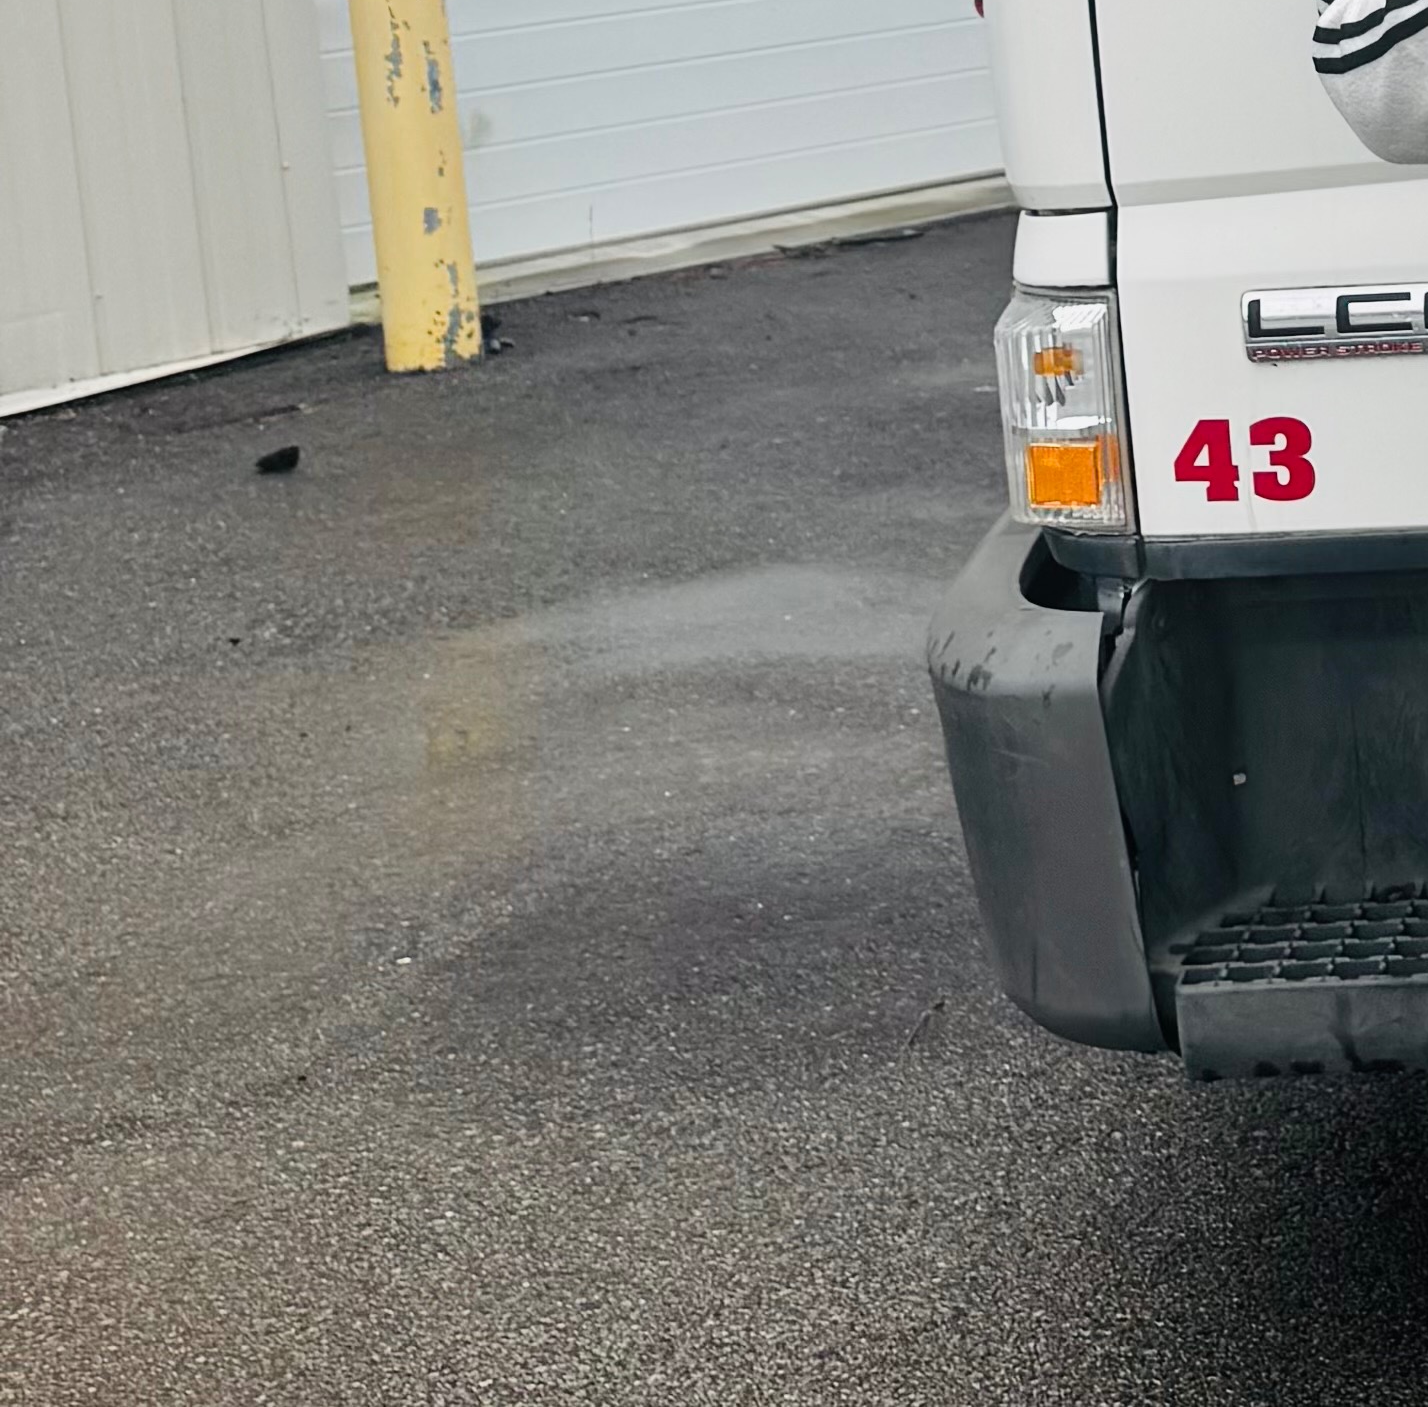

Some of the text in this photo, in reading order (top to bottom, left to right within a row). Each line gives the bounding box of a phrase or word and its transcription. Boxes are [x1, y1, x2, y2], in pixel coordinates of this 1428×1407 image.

[1252, 345, 1331, 361] POWER
[1335, 341, 1423, 357] STROKE
[1173, 416, 1316, 502] 43
